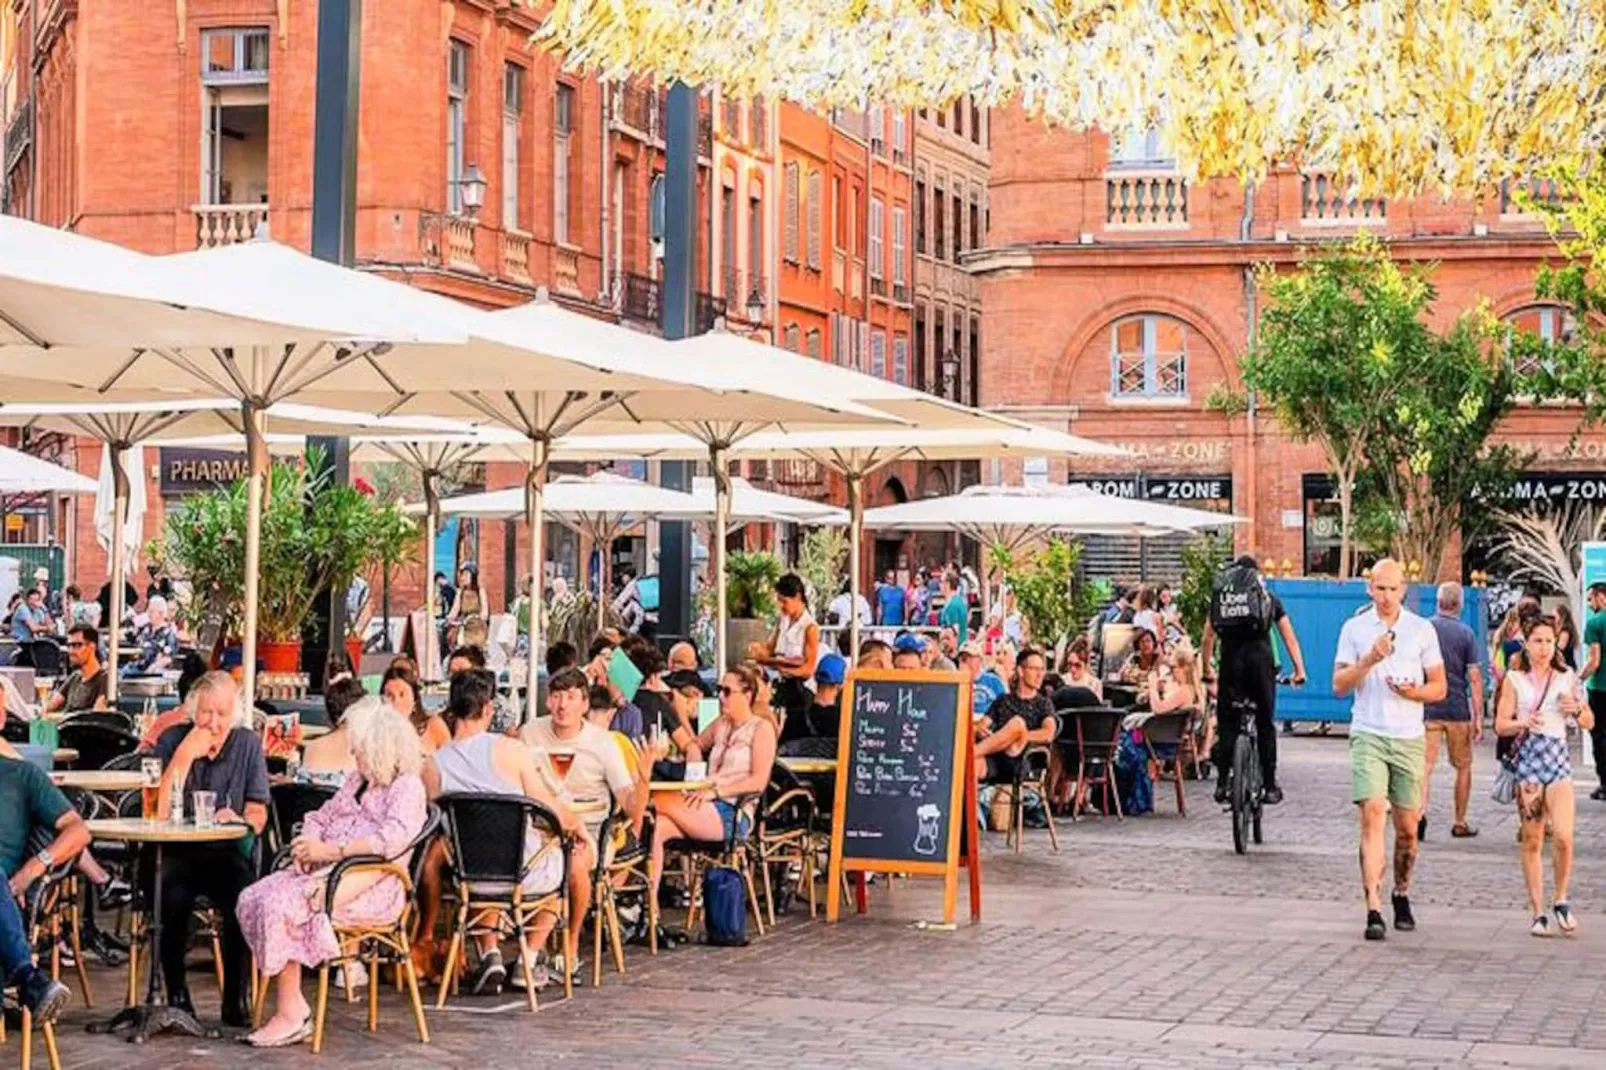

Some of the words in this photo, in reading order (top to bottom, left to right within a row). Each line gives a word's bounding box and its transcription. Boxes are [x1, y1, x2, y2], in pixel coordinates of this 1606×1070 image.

[1171, 442, 1227, 460] ZONE
[1167, 481, 1222, 498] ZONE
[1470, 481, 1548, 499] AMA
[1219, 592, 1248, 605] Uber
[1219, 605, 1250, 618] Eats
